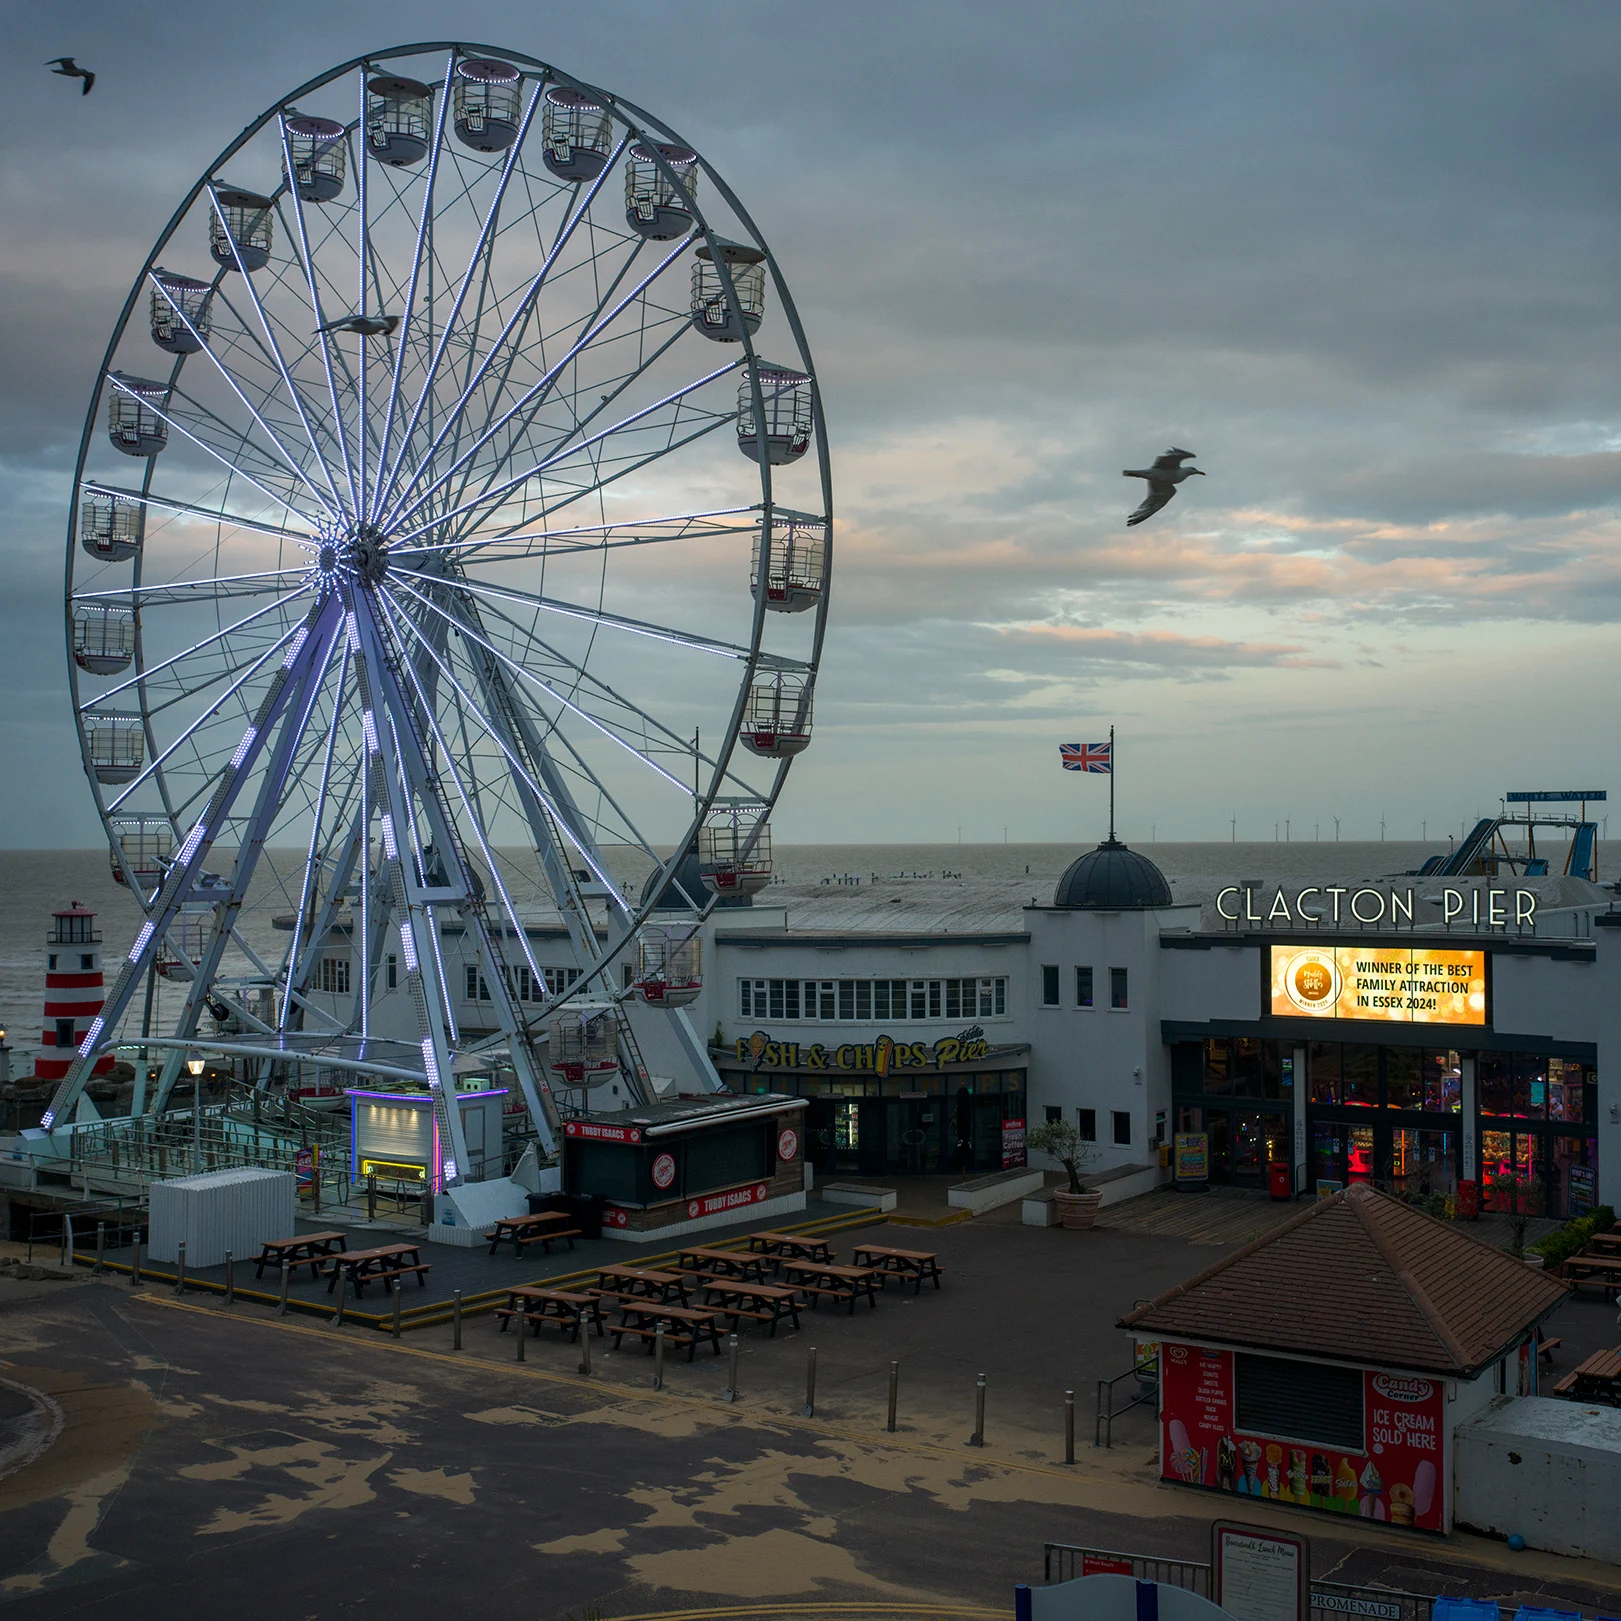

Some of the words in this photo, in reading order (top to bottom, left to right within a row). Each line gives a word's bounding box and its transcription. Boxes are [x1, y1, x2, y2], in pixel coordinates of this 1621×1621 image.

[1510, 791, 1551, 801] WHITE
[1559, 790, 1603, 801] WATER
[1215, 887, 1412, 923] CLACTON
[1443, 889, 1535, 926] PIER
[1356, 961, 1402, 975] WINNER
[1405, 963, 1420, 975] OF
[1423, 963, 1444, 977] THE
[1447, 965, 1474, 978] BEST
[1356, 978, 1397, 991] FAMILY
[1399, 980, 1469, 994] ATTRACTION
[1357, 995, 1370, 1007] IN
[1373, 996, 1404, 1009] ESSEX
[1406, 997, 1437, 1011] 2024!
[806, 1043, 831, 1070] &
[932, 1036, 987, 1071] Pier
[581, 1125, 602, 1137] TUBBY
[602, 1127, 625, 1140] ISAACS
[704, 1195, 727, 1213] TUBBY
[726, 1189, 752, 1207] ISAACS
[1376, 1373, 1430, 1397] Candy
[1387, 1390, 1420, 1401] Corner
[1373, 1408, 1391, 1426] ICE
[1393, 1411, 1435, 1432] CREAM
[1372, 1426, 1404, 1446] SOLD
[1406, 1431, 1437, 1451] HERE
[1276, 1545, 1296, 1558] Menu
[1310, 1594, 1397, 1618] PROMENADE
